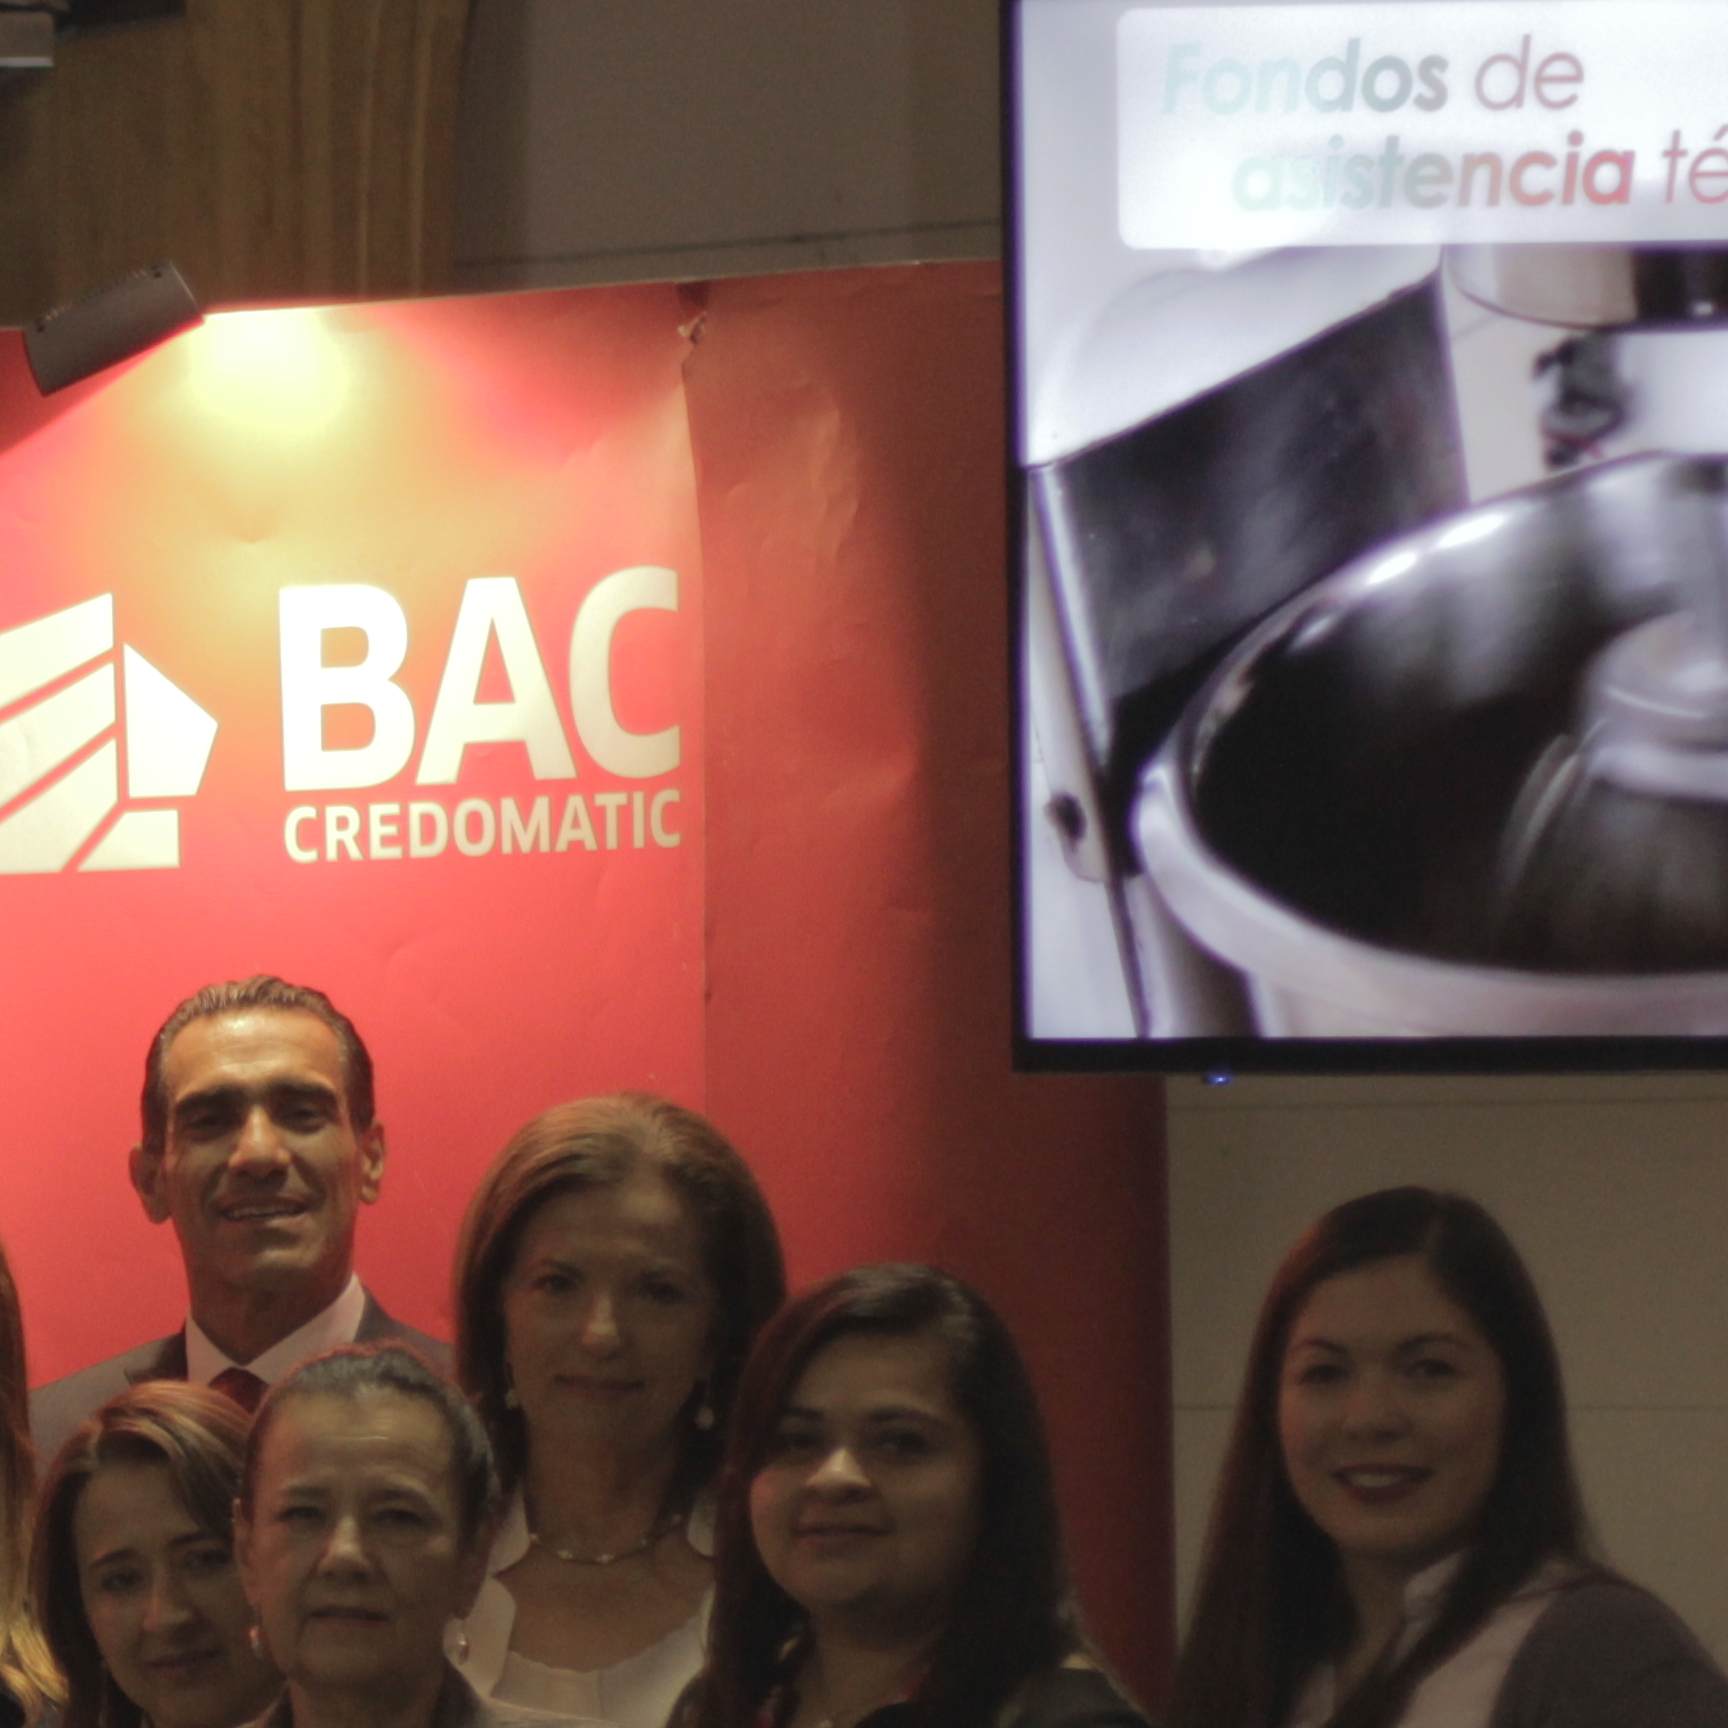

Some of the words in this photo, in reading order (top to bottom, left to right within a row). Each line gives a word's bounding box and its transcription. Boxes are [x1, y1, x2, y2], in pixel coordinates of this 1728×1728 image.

[1161, 38, 1449, 115] Fondos
[1474, 34, 1585, 111] de
[1232, 130, 1636, 212] asistencia
[278, 565, 681, 791] BAC
[283, 789, 682, 864] CREDOMATIC
